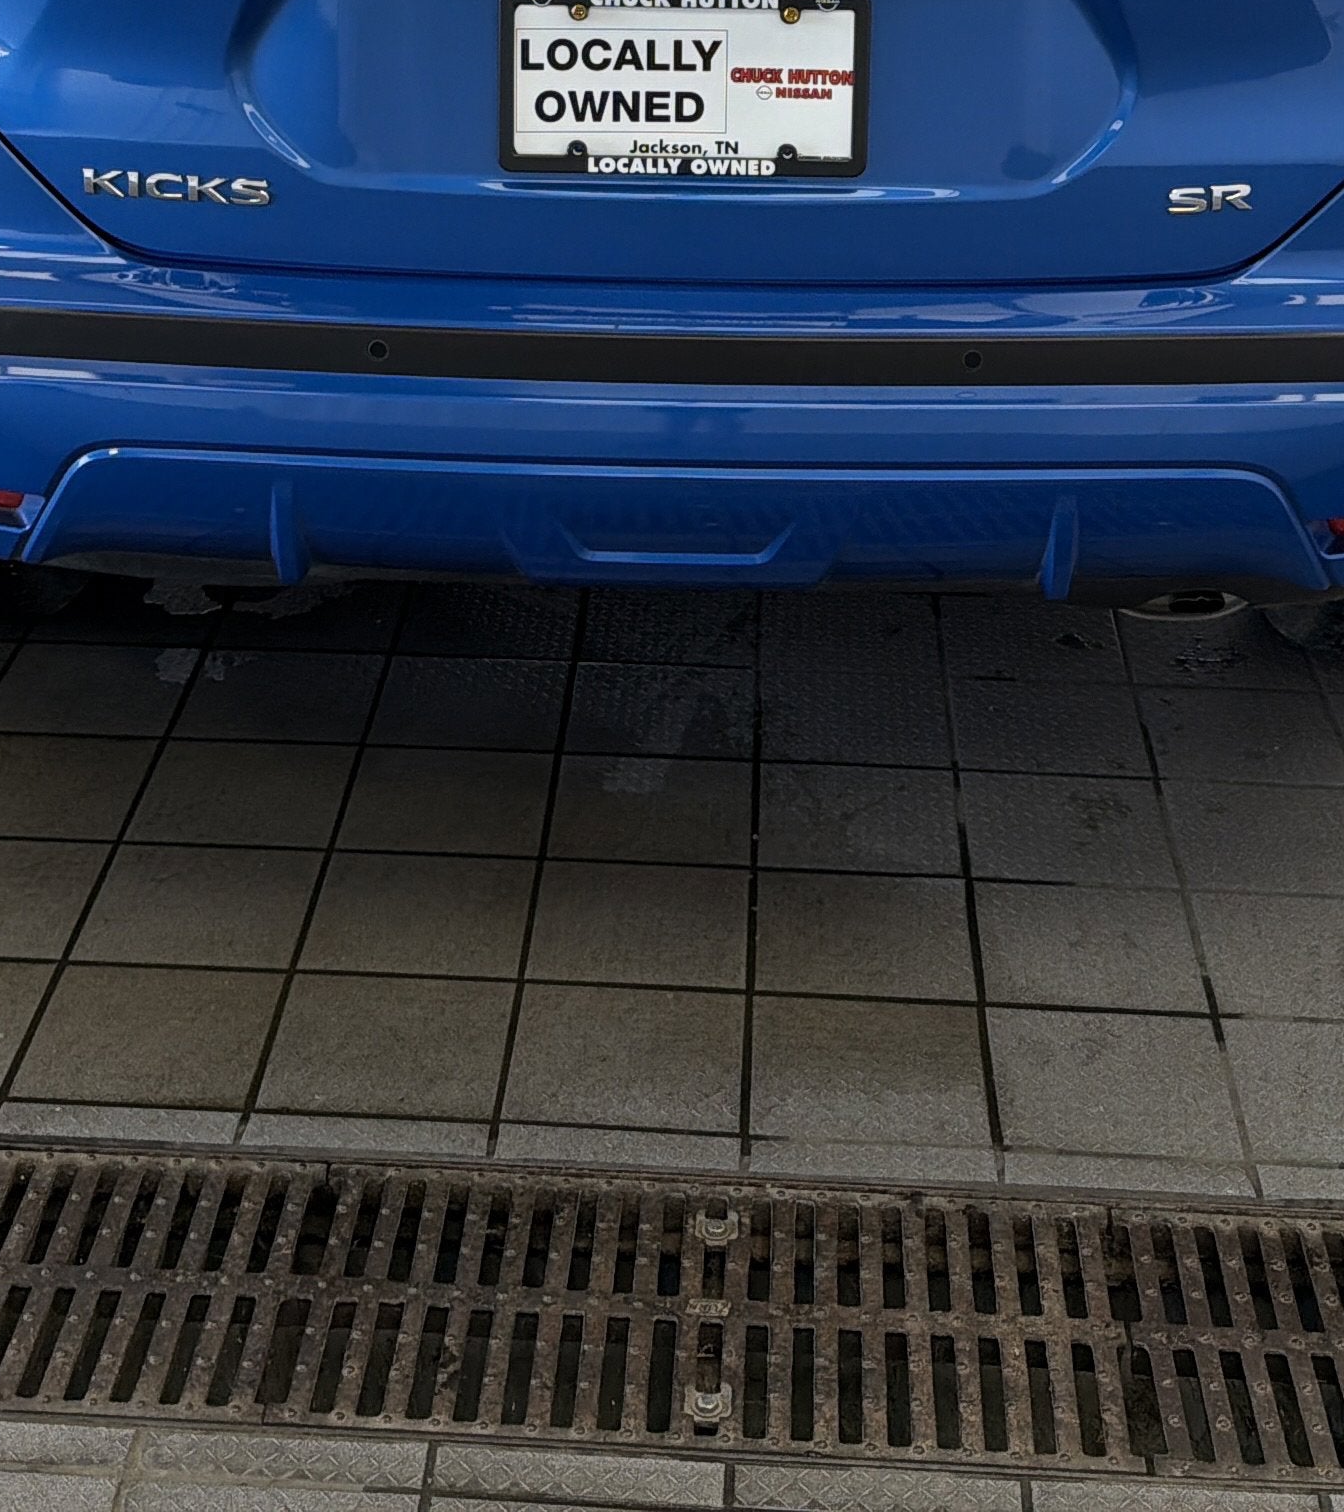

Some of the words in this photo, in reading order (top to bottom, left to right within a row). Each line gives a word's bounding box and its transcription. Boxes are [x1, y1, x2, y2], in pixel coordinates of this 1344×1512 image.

[520, 38, 723, 72] LOCALLY
[730, 67, 784, 84] CHUCK
[787, 68, 855, 86] HUTTON
[775, 87, 832, 100] NISSAN
[534, 90, 705, 123] OWNED
[629, 139, 708, 157] Jackson,
[714, 141, 739, 155] TN
[587, 157, 682, 175] LOCALLY
[690, 158, 776, 177] OWNED
[82, 167, 270, 205] KICKS
[1167, 183, 1253, 213] SR
